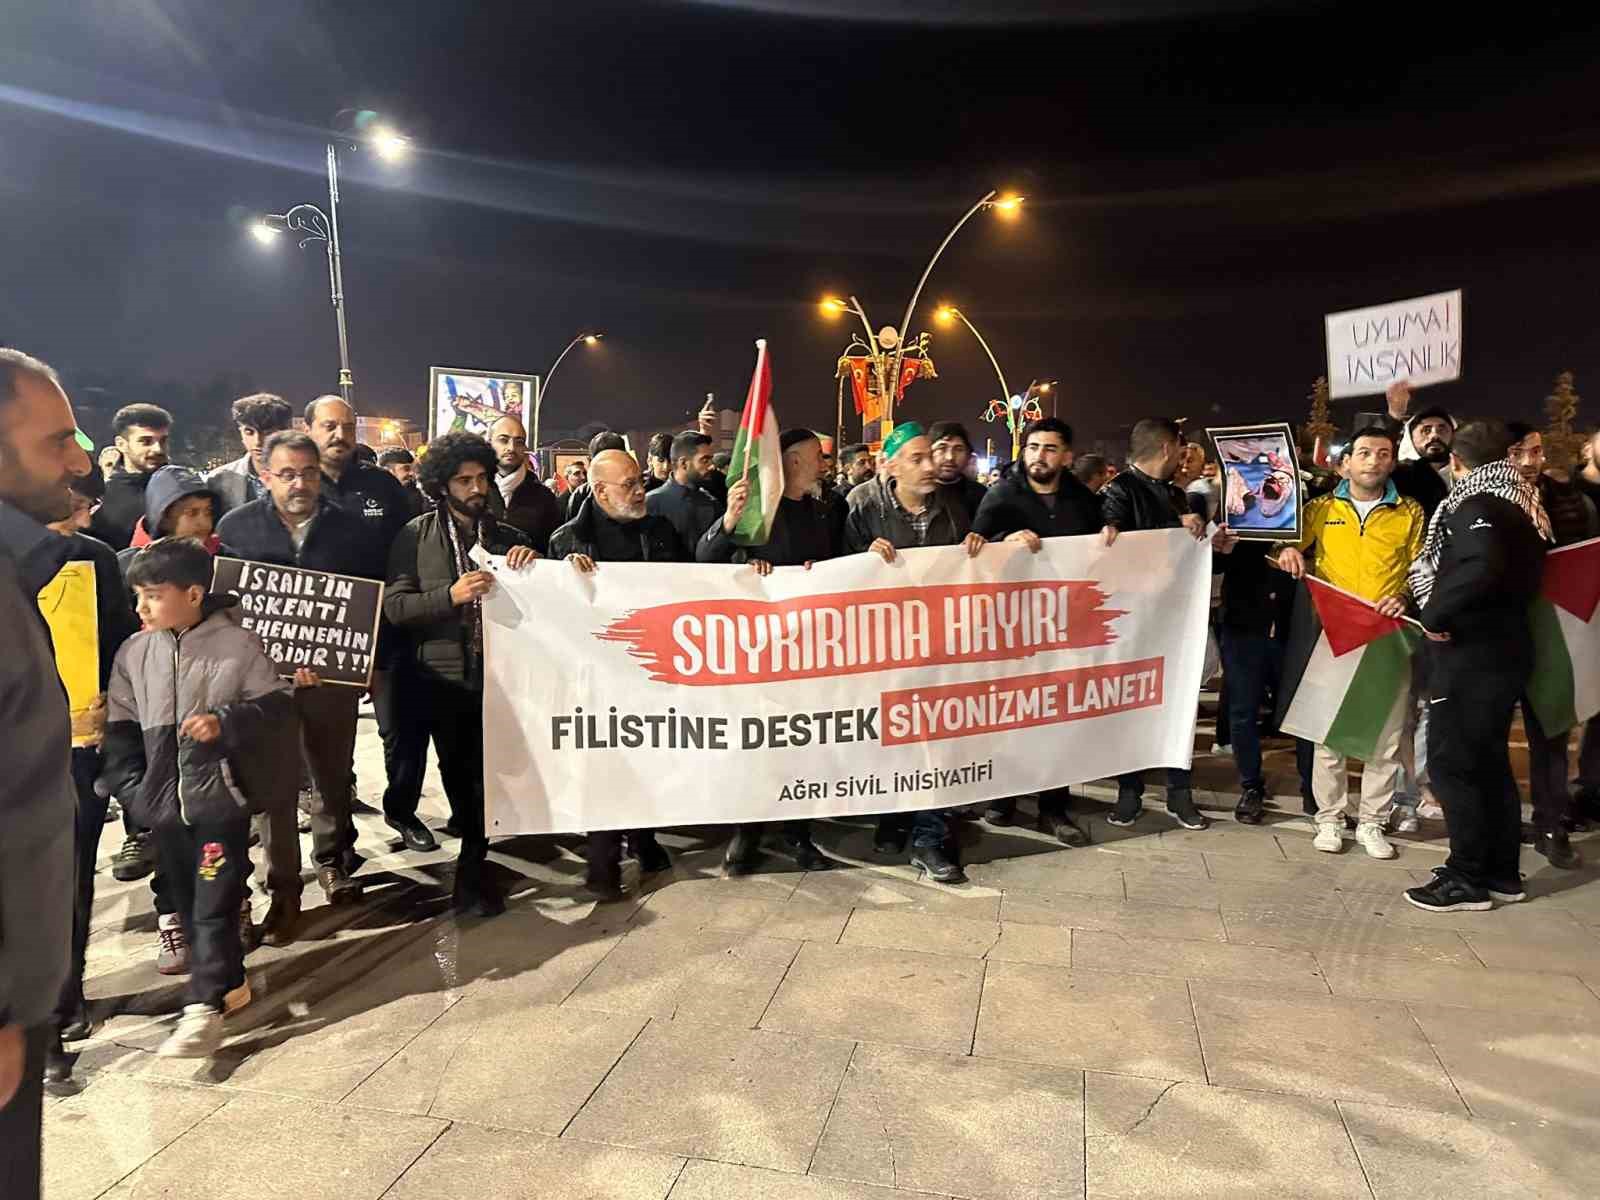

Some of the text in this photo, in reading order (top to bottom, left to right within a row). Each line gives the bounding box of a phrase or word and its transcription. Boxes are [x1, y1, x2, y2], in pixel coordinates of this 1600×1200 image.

[227, 589, 348, 623] AŞKENTİ
[241, 616, 369, 650] EHENNEMİN
[672, 585, 1069, 676] SOYKIRIMA HAYIR!
[551, 668, 1157, 750] FİLİSTİNE DESTEK SİYONİZME LANET!
[779, 759, 993, 801] AĞRI SİVİL İNİSİYATİFİ
